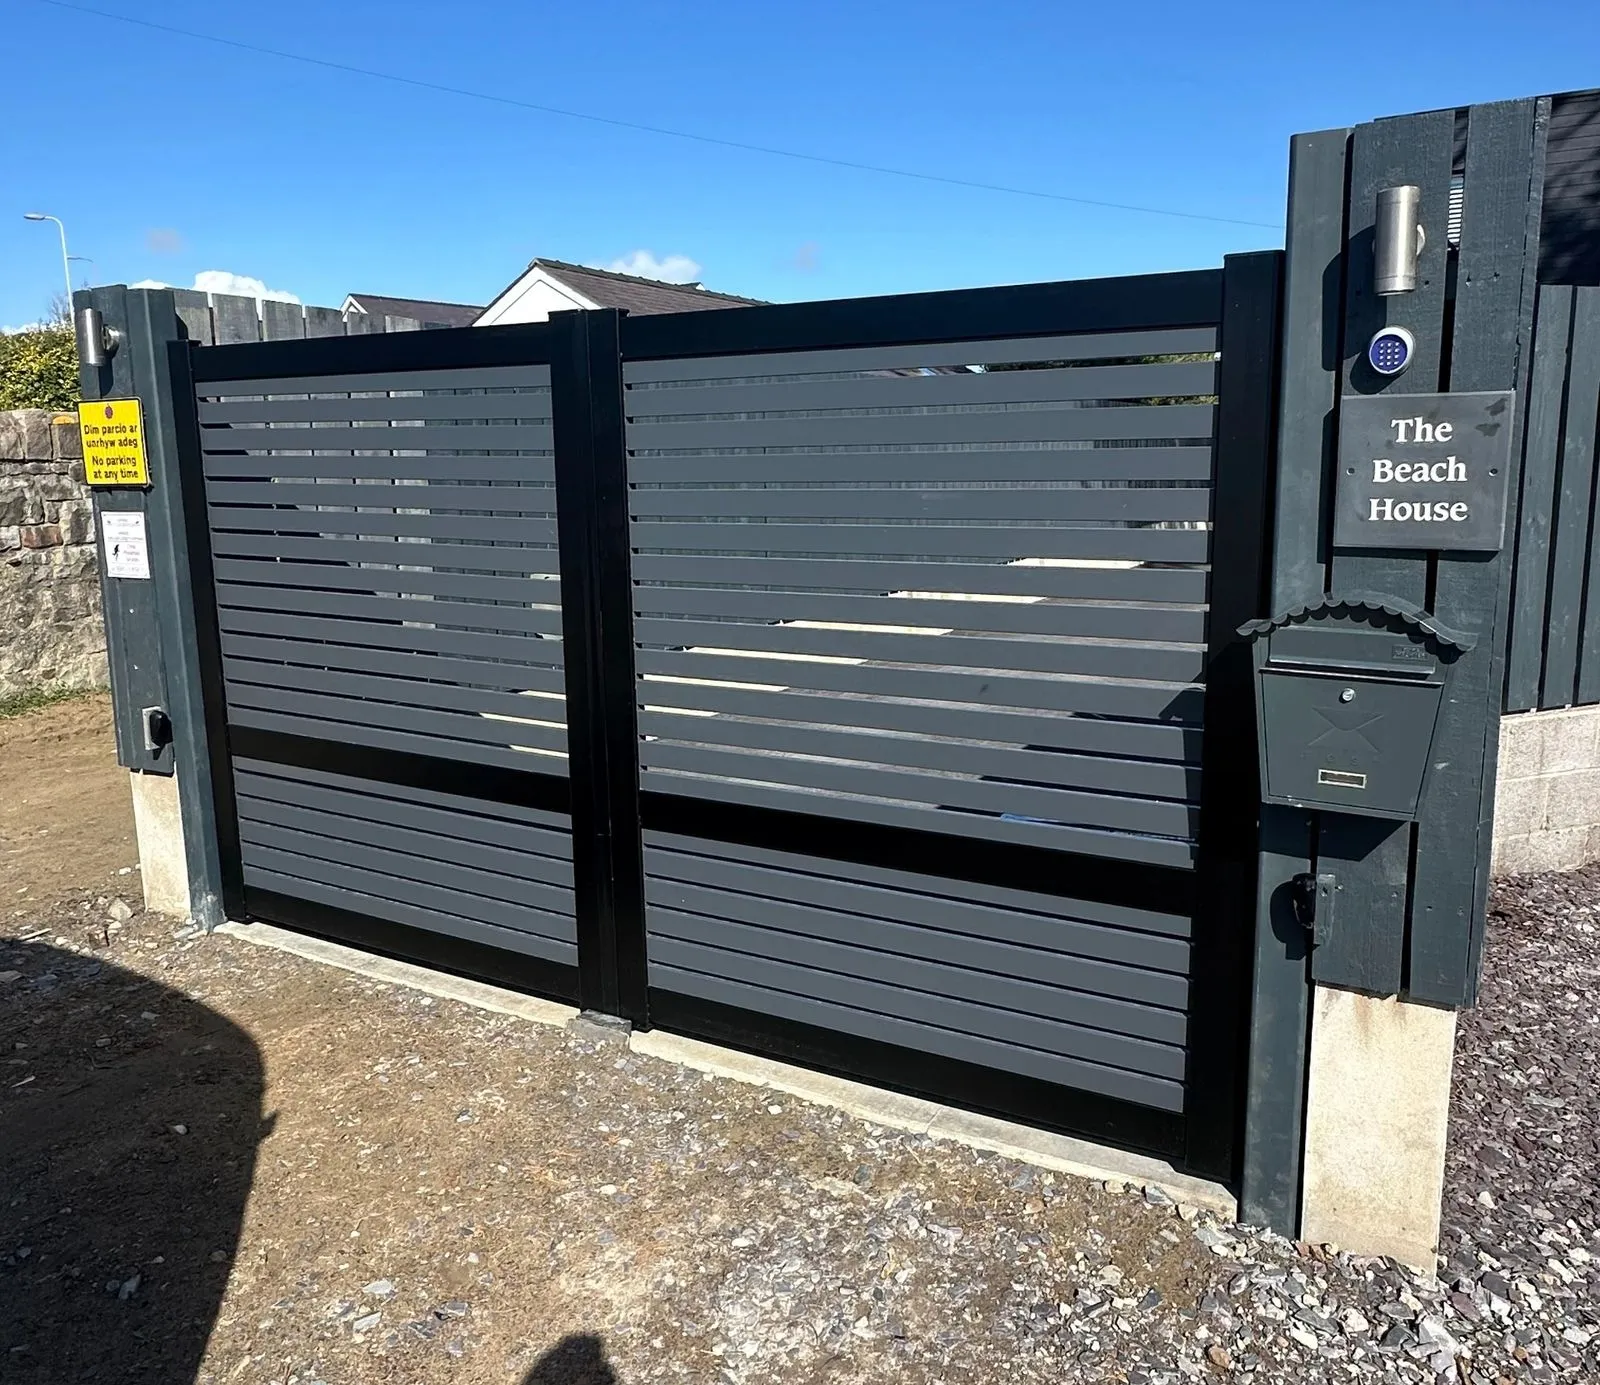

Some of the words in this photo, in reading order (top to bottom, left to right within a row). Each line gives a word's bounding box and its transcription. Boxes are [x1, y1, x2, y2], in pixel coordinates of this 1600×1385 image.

[84, 425, 99, 434] Dim
[102, 423, 126, 435] parcio
[1391, 416, 1453, 443] The
[118, 438, 138, 448] adeg
[92, 456, 103, 465] No
[106, 456, 136, 467] parking
[93, 469, 102, 478] at
[104, 469, 118, 480] any
[120, 468, 138, 478] time
[1372, 456, 1467, 483] Beach
[1368, 498, 1468, 522] House
